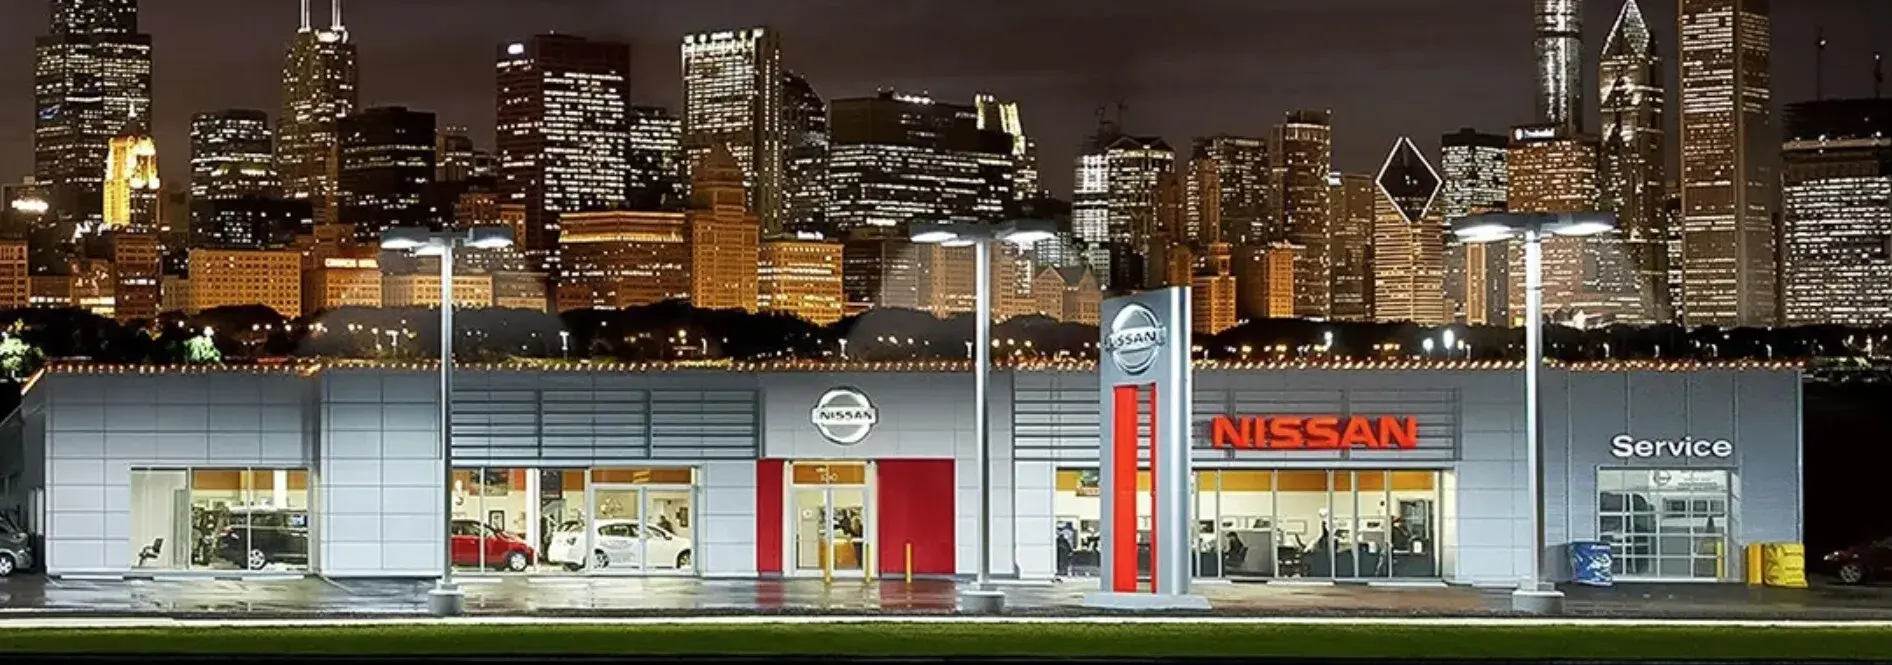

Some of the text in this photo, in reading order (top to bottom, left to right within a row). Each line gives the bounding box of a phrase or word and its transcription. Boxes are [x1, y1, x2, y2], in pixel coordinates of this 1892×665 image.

[1104, 331, 1156, 347] NSSAN
[820, 410, 872, 420] NISSAN
[1213, 415, 1418, 450] NISSAN
[1612, 434, 1732, 458] Service
